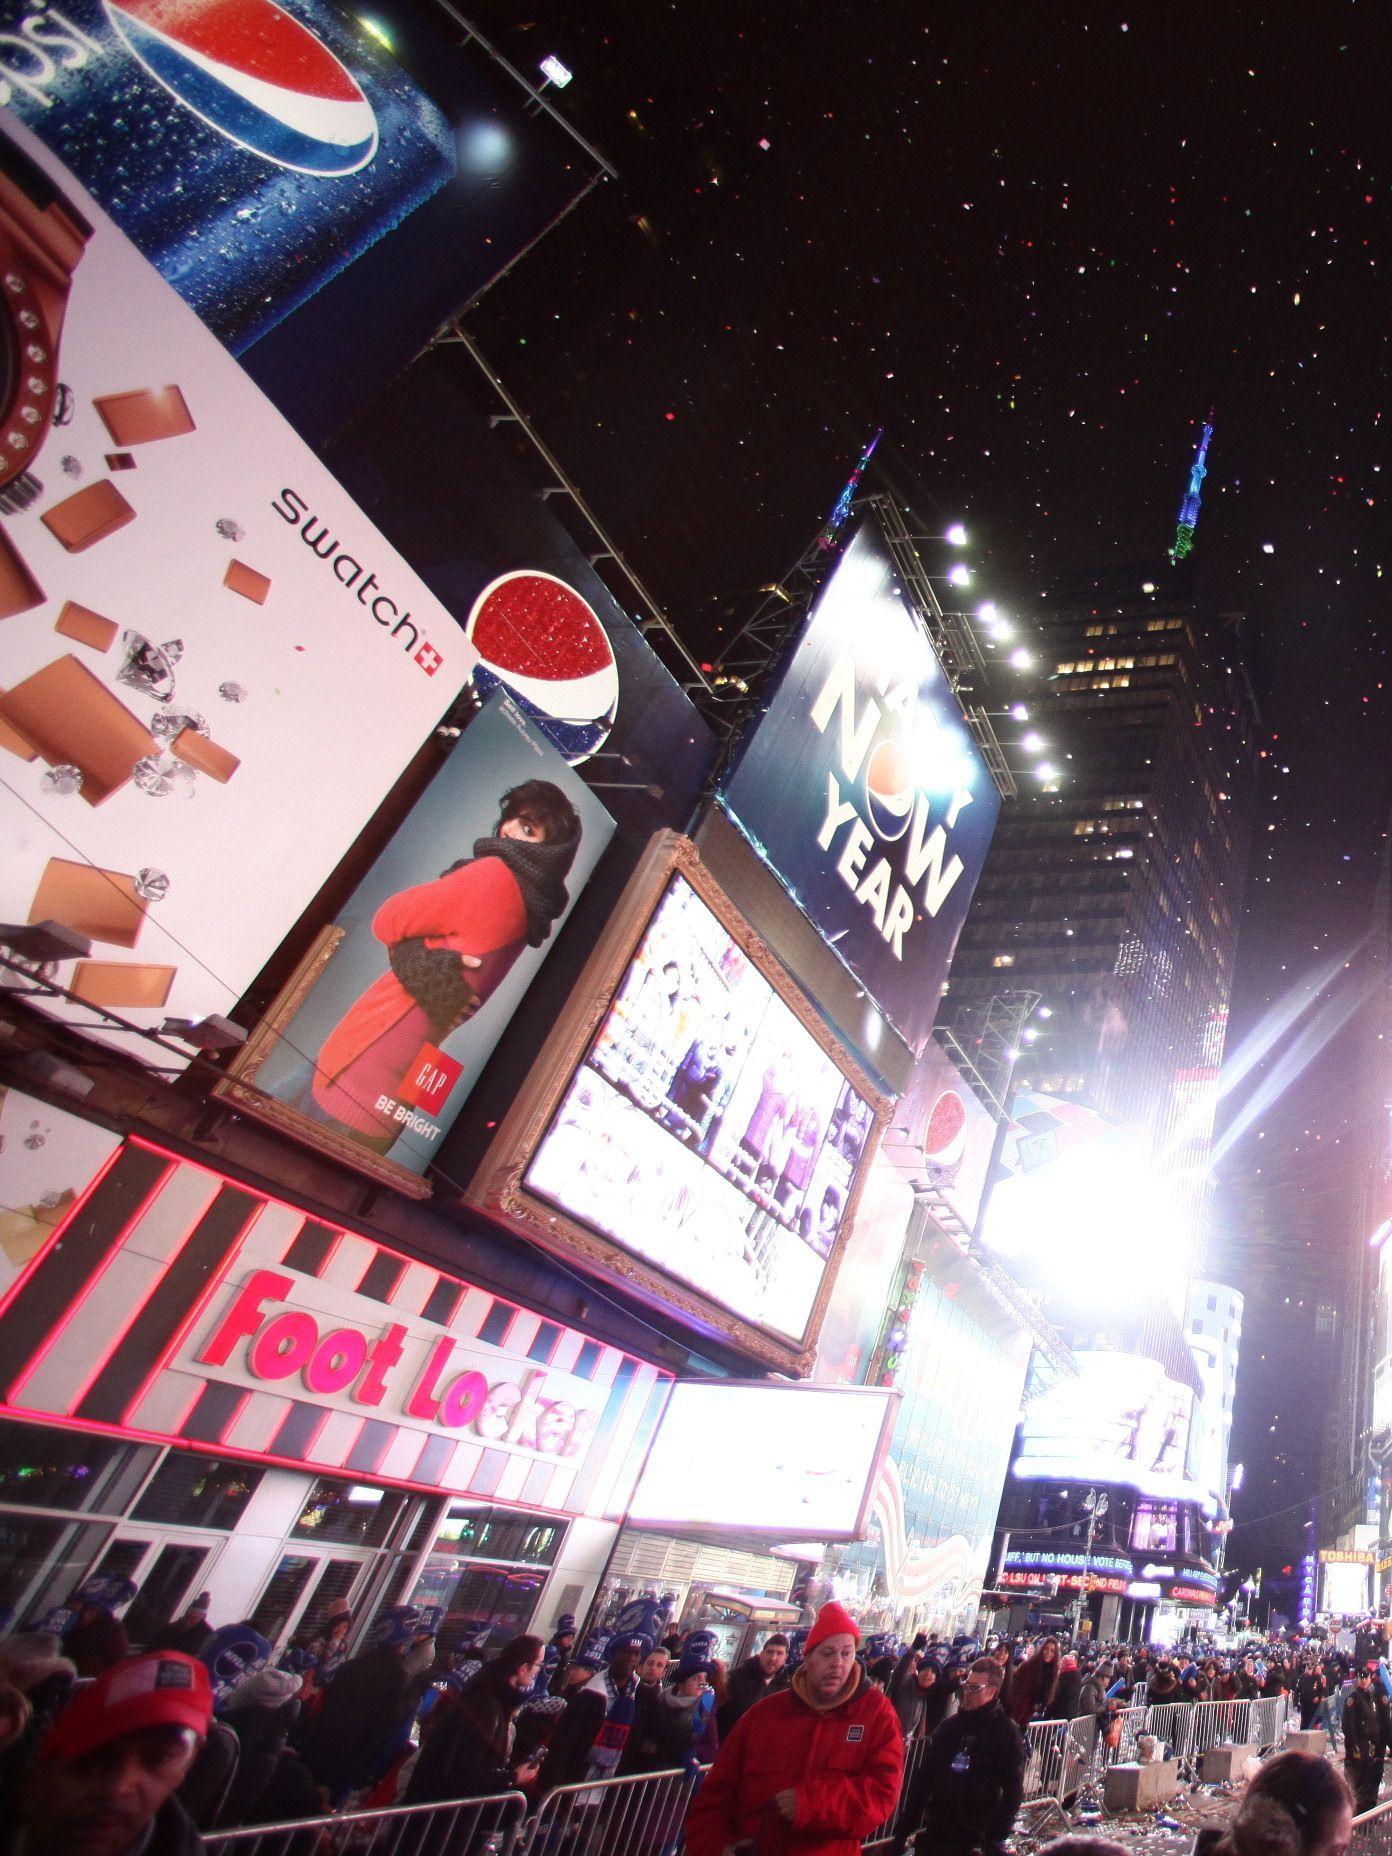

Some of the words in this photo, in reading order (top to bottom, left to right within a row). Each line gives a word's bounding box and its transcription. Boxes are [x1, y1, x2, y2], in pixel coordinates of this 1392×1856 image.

[272, 487, 420, 652] swatch
[817, 771, 914, 961] YEAR
[415, 1062, 447, 1095] GAP
[374, 1094, 397, 1115] BE
[393, 1105, 441, 1141] BRIGHT
[194, 1268, 408, 1408] Foot
[402, 1333, 602, 1459] Locker
[1025, 1552, 1041, 1563] BUT
[1042, 1553, 1055, 1564] NO
[1093, 1555, 1114, 1568] VOTE
[1320, 1551, 1375, 1564] TOSHIBA
[1009, 1572, 1026, 1584] LSU
